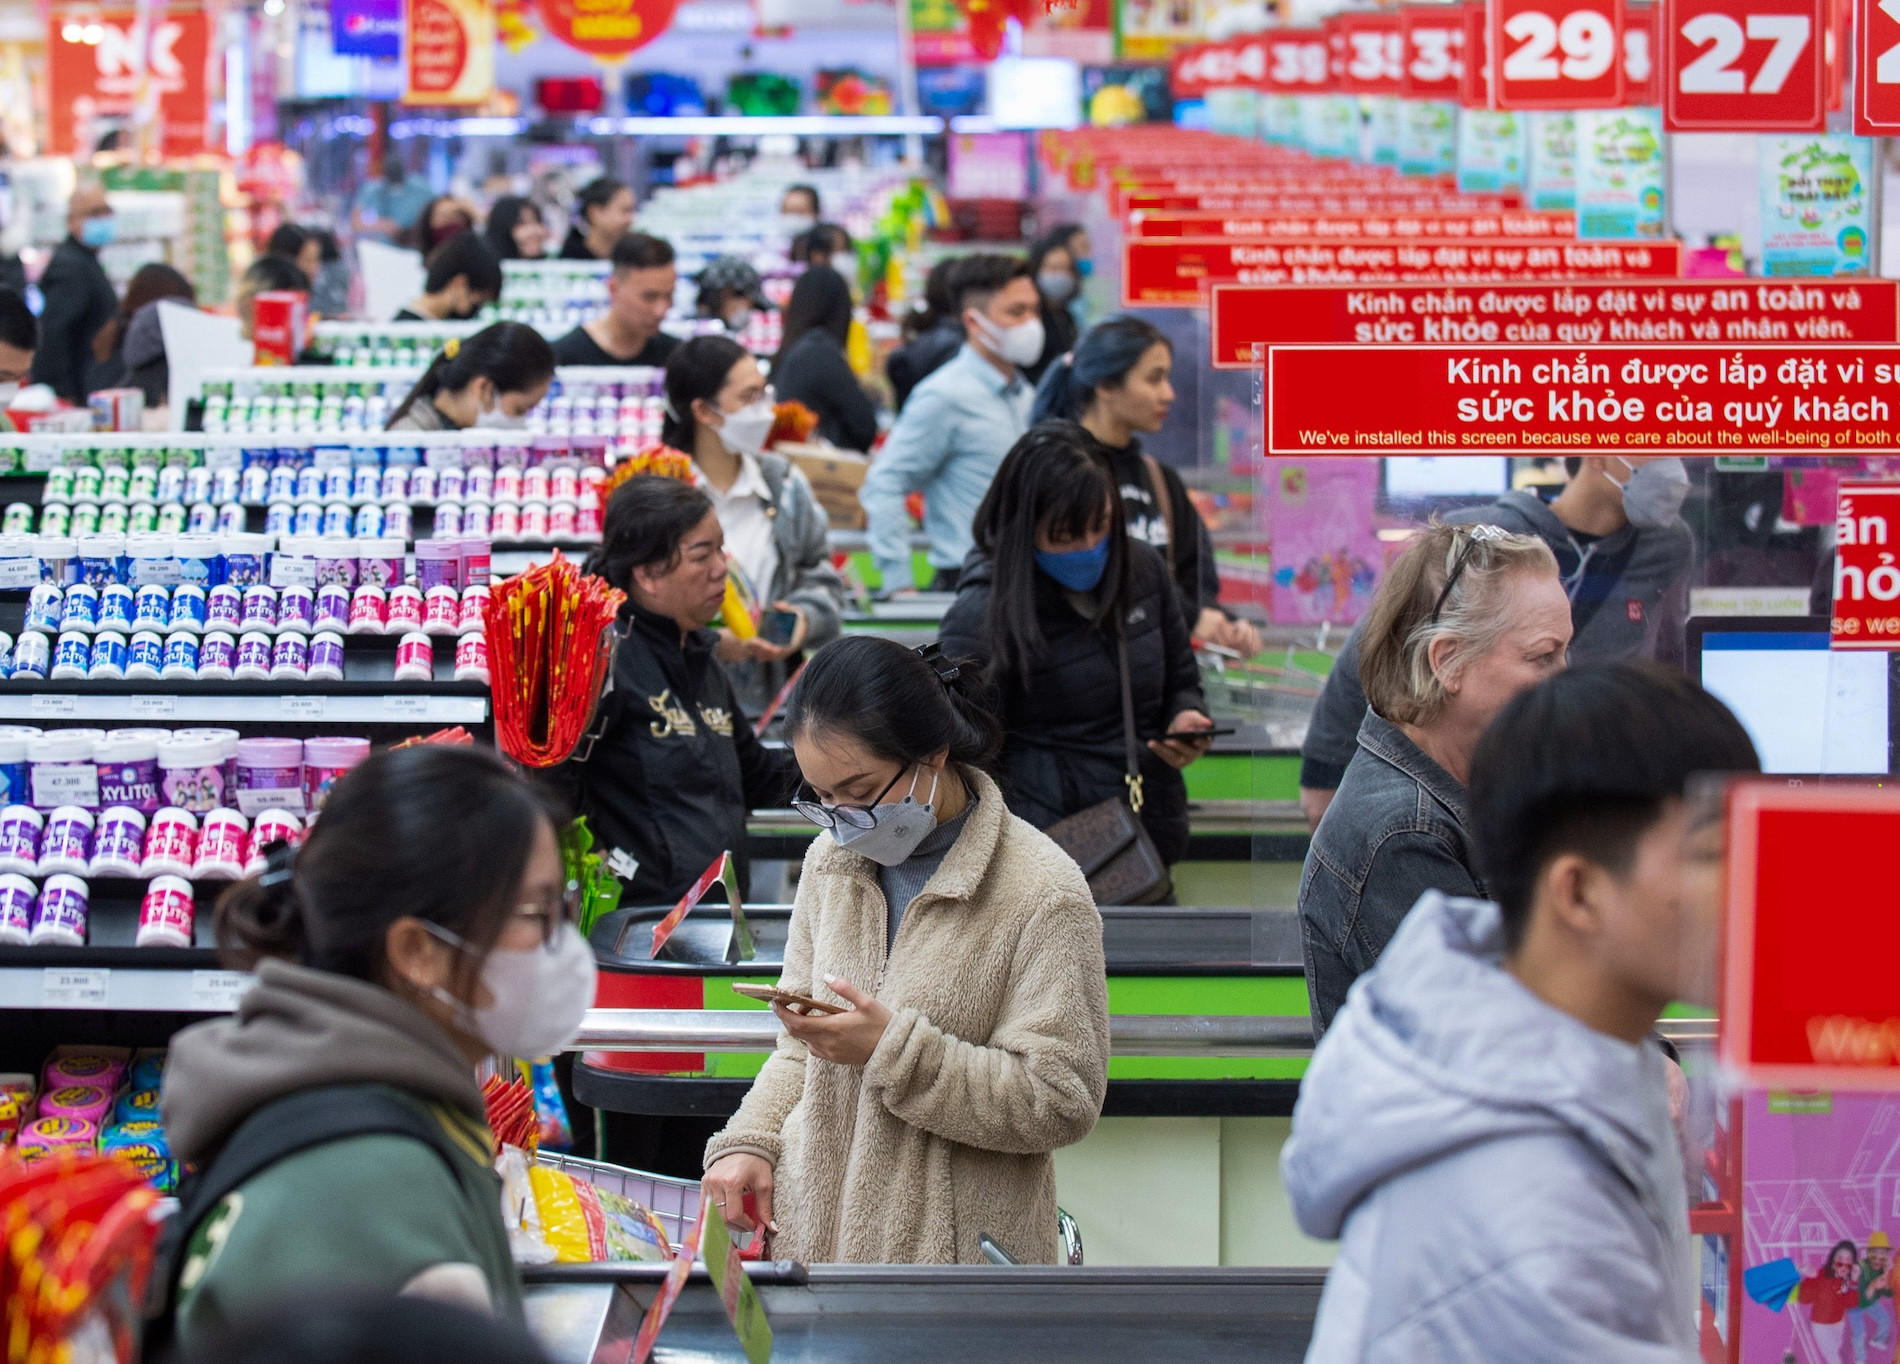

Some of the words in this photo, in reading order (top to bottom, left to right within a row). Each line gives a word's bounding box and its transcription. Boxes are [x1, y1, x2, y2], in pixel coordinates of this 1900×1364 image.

[1503, 10, 1615, 81] 29
[1680, 12, 1811, 94] 27
[1347, 291, 1405, 314] Kính
[1412, 287, 1472, 314] chắn
[1479, 291, 1546, 316] được
[1554, 287, 1591, 317] lắp
[1597, 289, 1636, 316] đặt
[1643, 287, 1664, 312] vì
[1671, 294, 1705, 316] sự
[1711, 290, 1748, 312] an
[1757, 285, 1825, 312] toàn
[1832, 288, 1861, 310] và
[1356, 316, 1415, 341] sức
[1424, 315, 1499, 341] khỏe
[1506, 318, 1550, 341] của
[1557, 318, 1603, 343] quý
[1611, 318, 1684, 340] khách
[1692, 319, 1720, 339] và
[1727, 318, 1787, 339] nhân
[1448, 358, 1521, 383] Kính
[1532, 352, 1609, 383] chắn
[1621, 358, 1708, 389] được
[1720, 352, 1767, 389] lắp
[1777, 358, 1827, 389] đặt
[1837, 357, 1864, 383] vì
[1874, 363, 1900, 383] s
[1457, 390, 1534, 421] sức
[1548, 389, 1645, 421] khỏe
[1656, 395, 1713, 421] của
[1723, 395, 1782, 428] quý
[1793, 395, 1888, 421] khách
[1299, 430, 1350, 444] We've
[1355, 430, 1422, 444] installed
[1428, 430, 1456, 444] this
[1461, 433, 1517, 445] screen
[1522, 430, 1591, 444] because
[1597, 433, 1620, 444] we
[1625, 433, 1661, 445] care
[1666, 430, 1712, 444] about
[1718, 430, 1742, 444] the
[1747, 430, 1830, 447] well-being
[1835, 429, 1851, 444] of
[1856, 430, 1891, 444] both
[101, 783, 156, 801] XYLITOL
